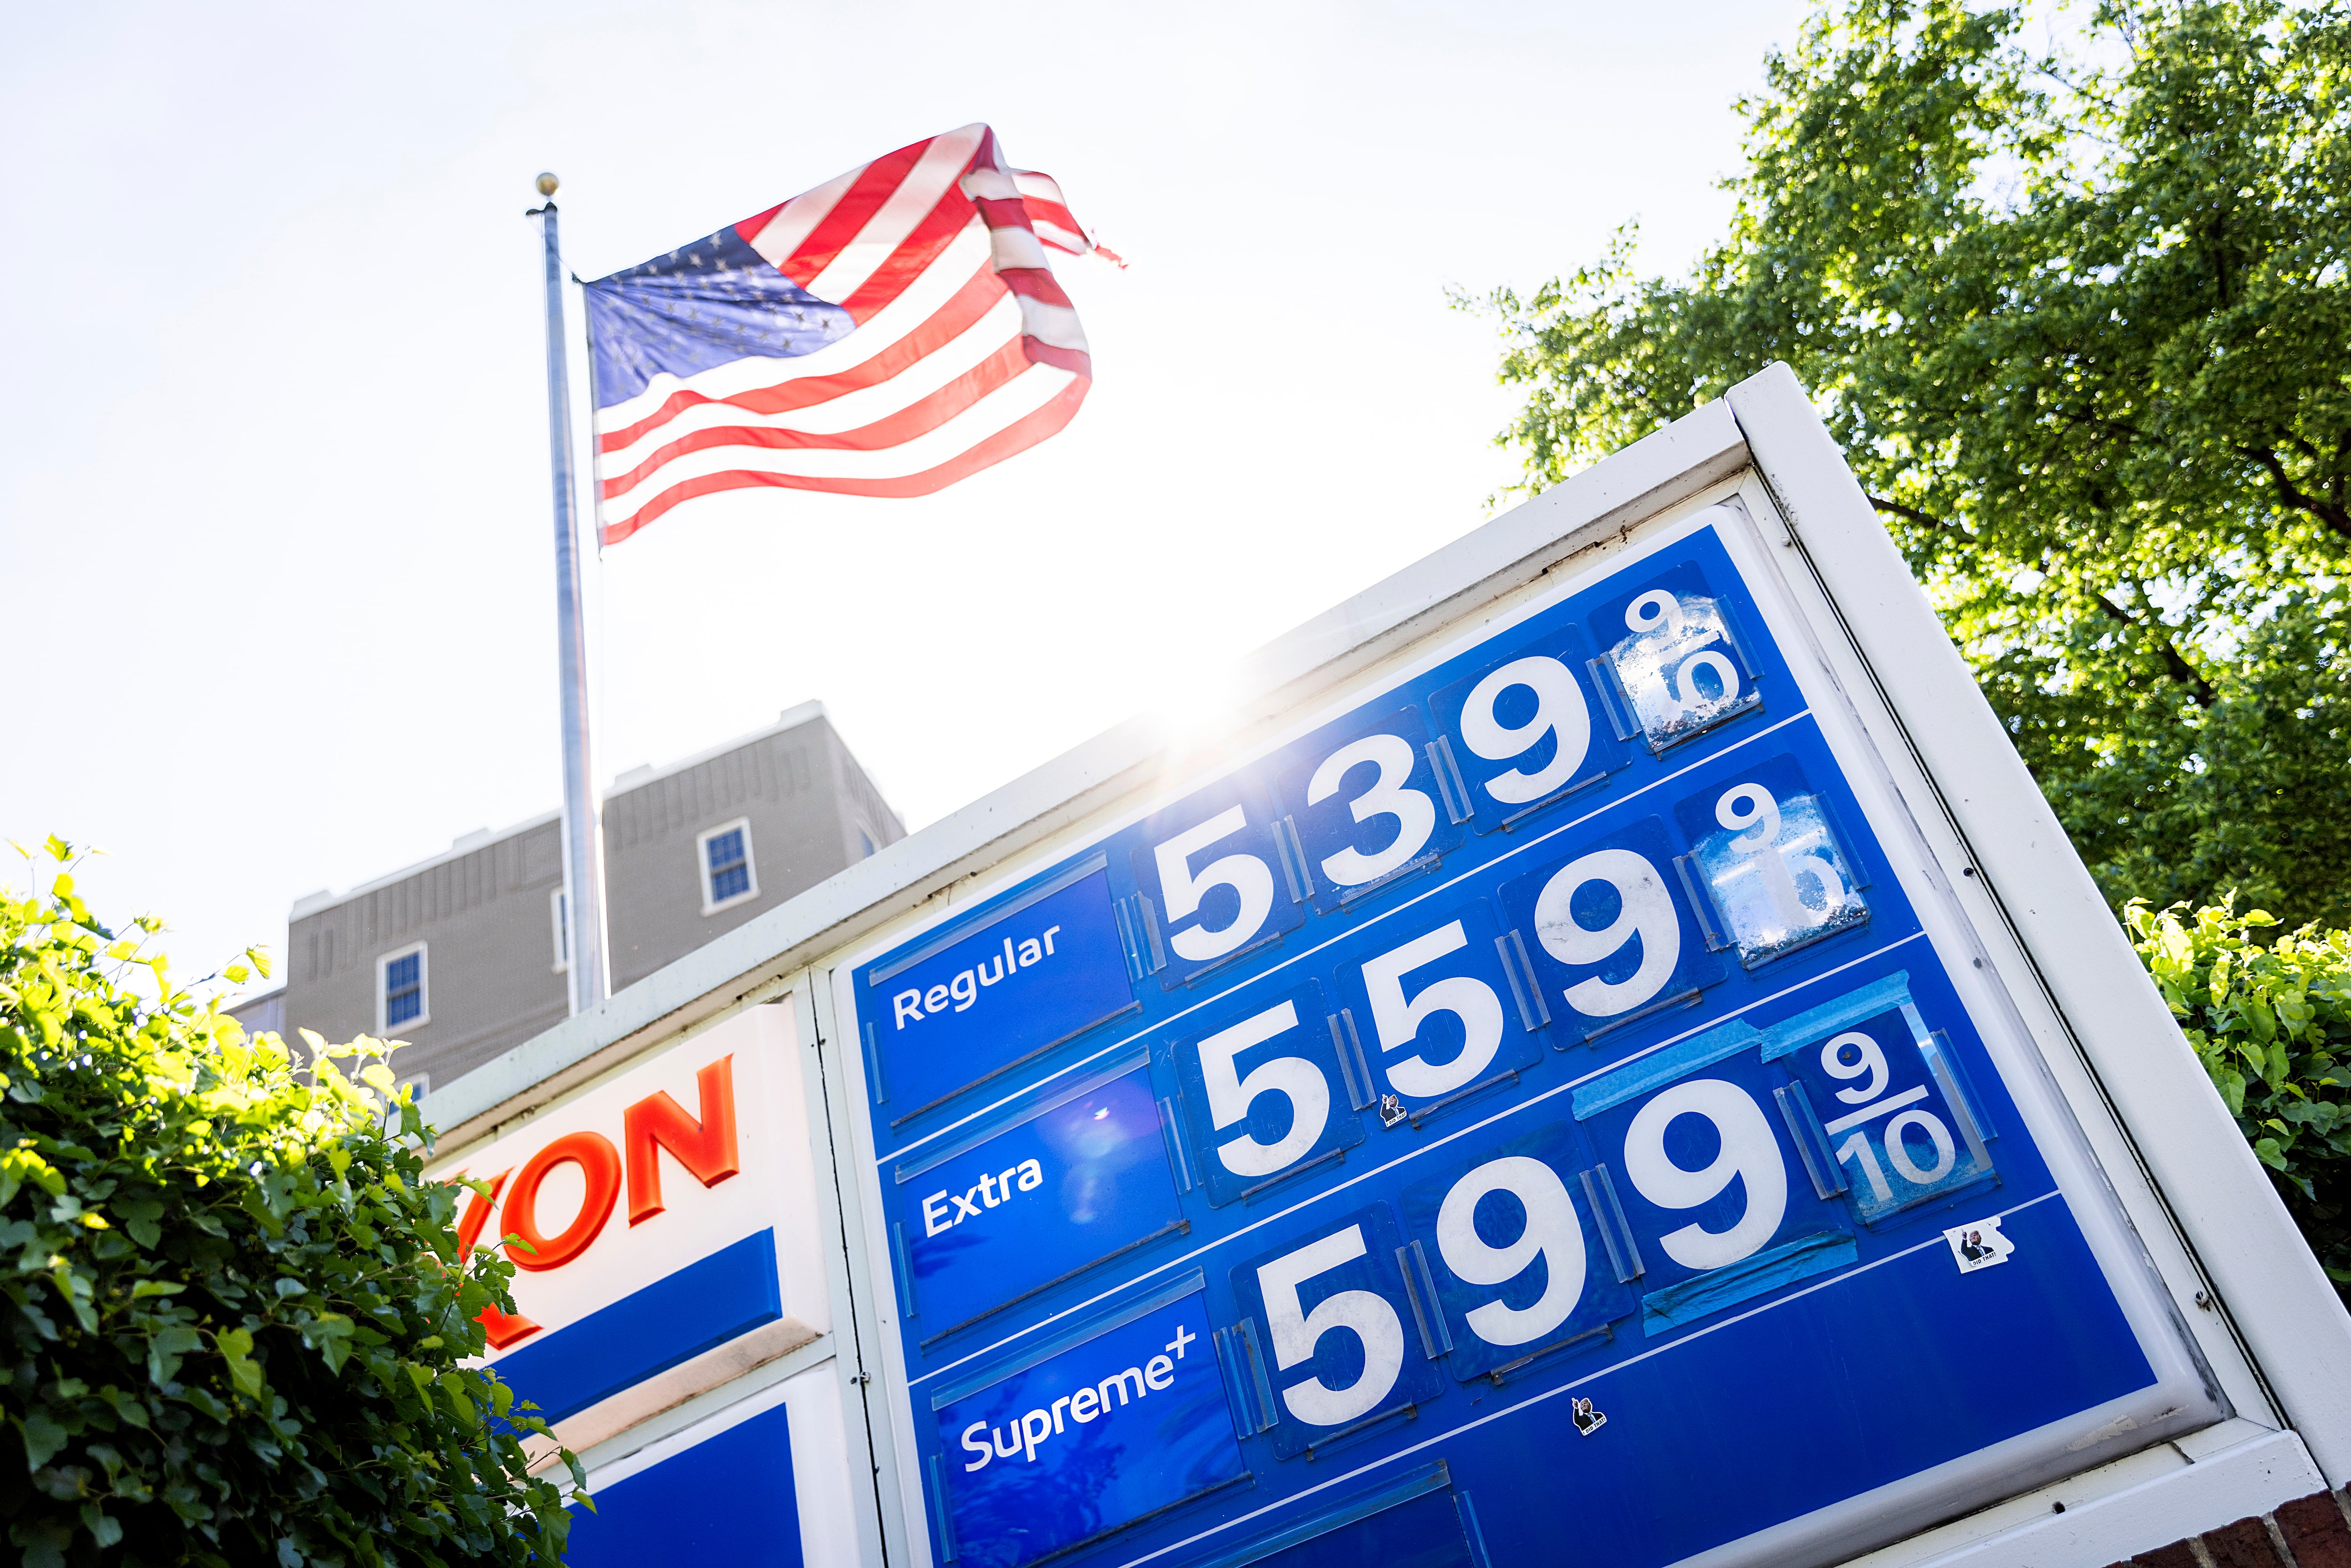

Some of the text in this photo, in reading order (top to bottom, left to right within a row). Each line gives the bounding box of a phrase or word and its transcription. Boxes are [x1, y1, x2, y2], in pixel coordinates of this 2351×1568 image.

[893, 925, 1060, 1031] Regular
[1153, 656, 1591, 961] 539
[922, 1158, 1043, 1238] Extra
[1197, 849, 1680, 1177] 559
[1256, 1079, 1787, 1426] 599
[1594, 1417, 1606, 1428] THAT!
[1983, 1252, 1996, 1261] THAT!
